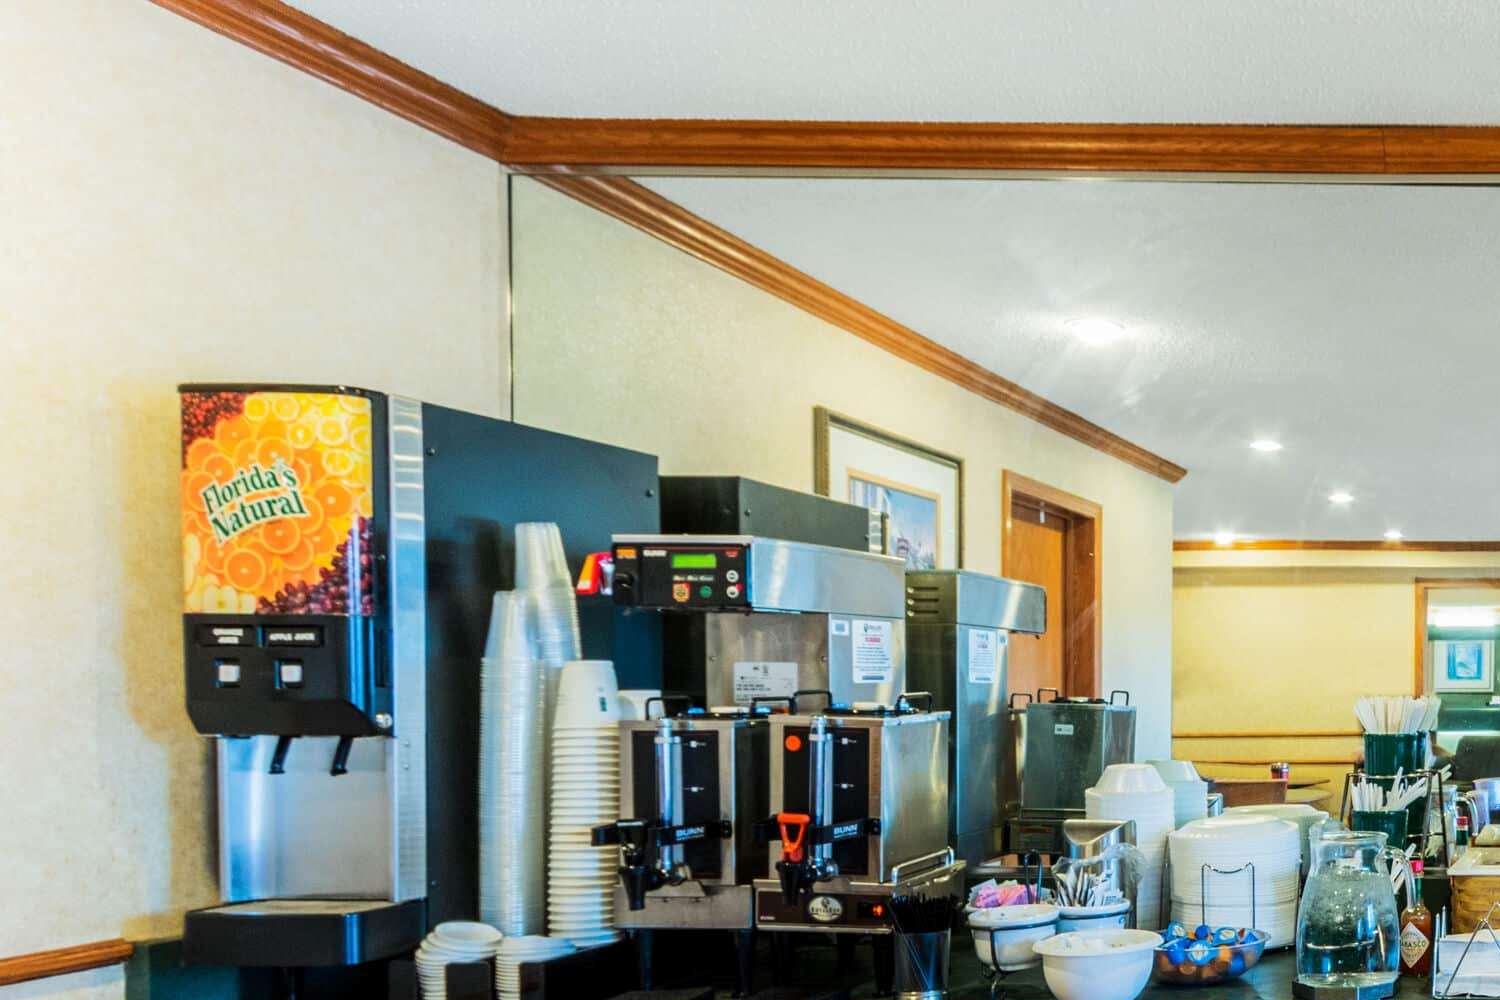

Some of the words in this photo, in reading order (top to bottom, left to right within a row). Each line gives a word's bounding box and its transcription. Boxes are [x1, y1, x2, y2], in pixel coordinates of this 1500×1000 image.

[202, 463, 297, 515] Florida's
[212, 489, 307, 543] Natural
[833, 823, 858, 836] BUNN
